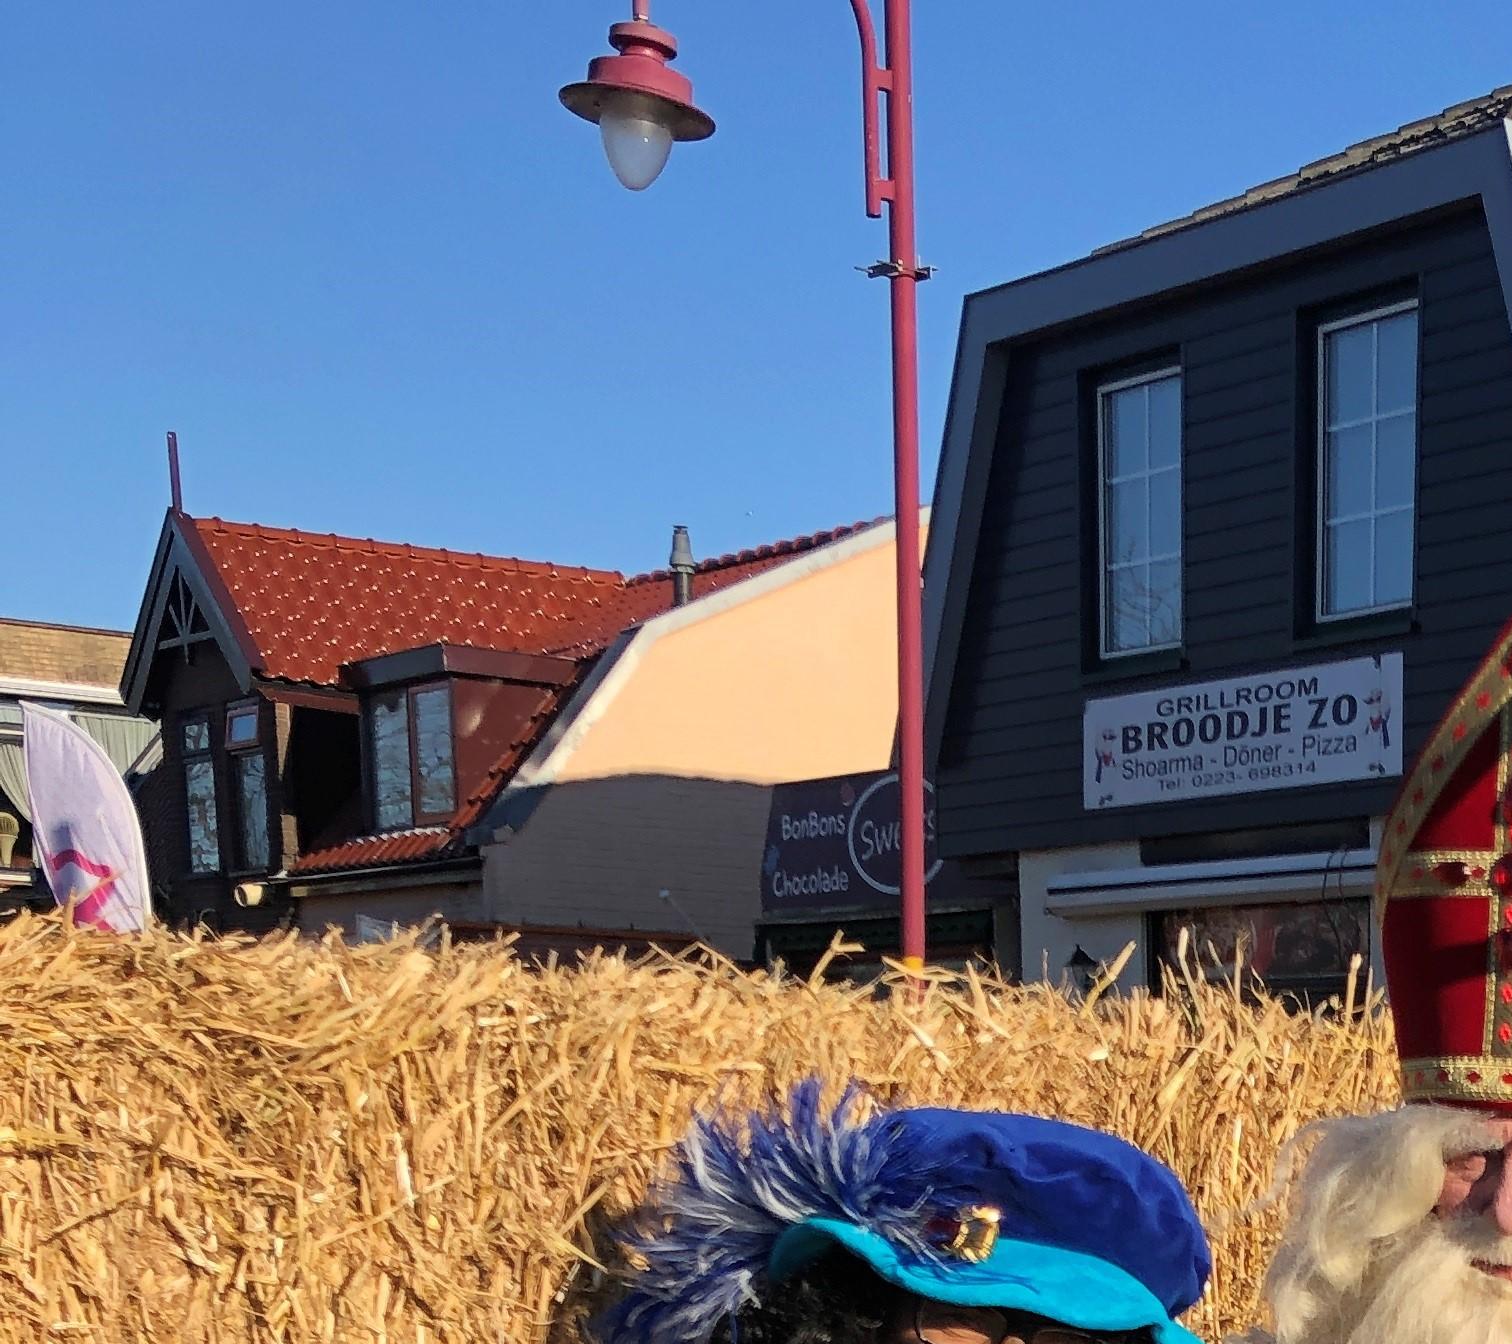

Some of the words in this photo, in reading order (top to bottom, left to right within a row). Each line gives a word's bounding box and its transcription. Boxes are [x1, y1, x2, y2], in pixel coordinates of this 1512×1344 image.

[1156, 676, 1319, 717] GRILLROOM
[1121, 703, 1291, 754] BROODJE
[1307, 694, 1358, 730] ZO
[1121, 754, 1204, 781] Shoarma
[1223, 743, 1283, 768] Döner
[1302, 734, 1357, 758] Pizza
[781, 810, 847, 841] BonBons
[772, 865, 850, 898] Chocolade
